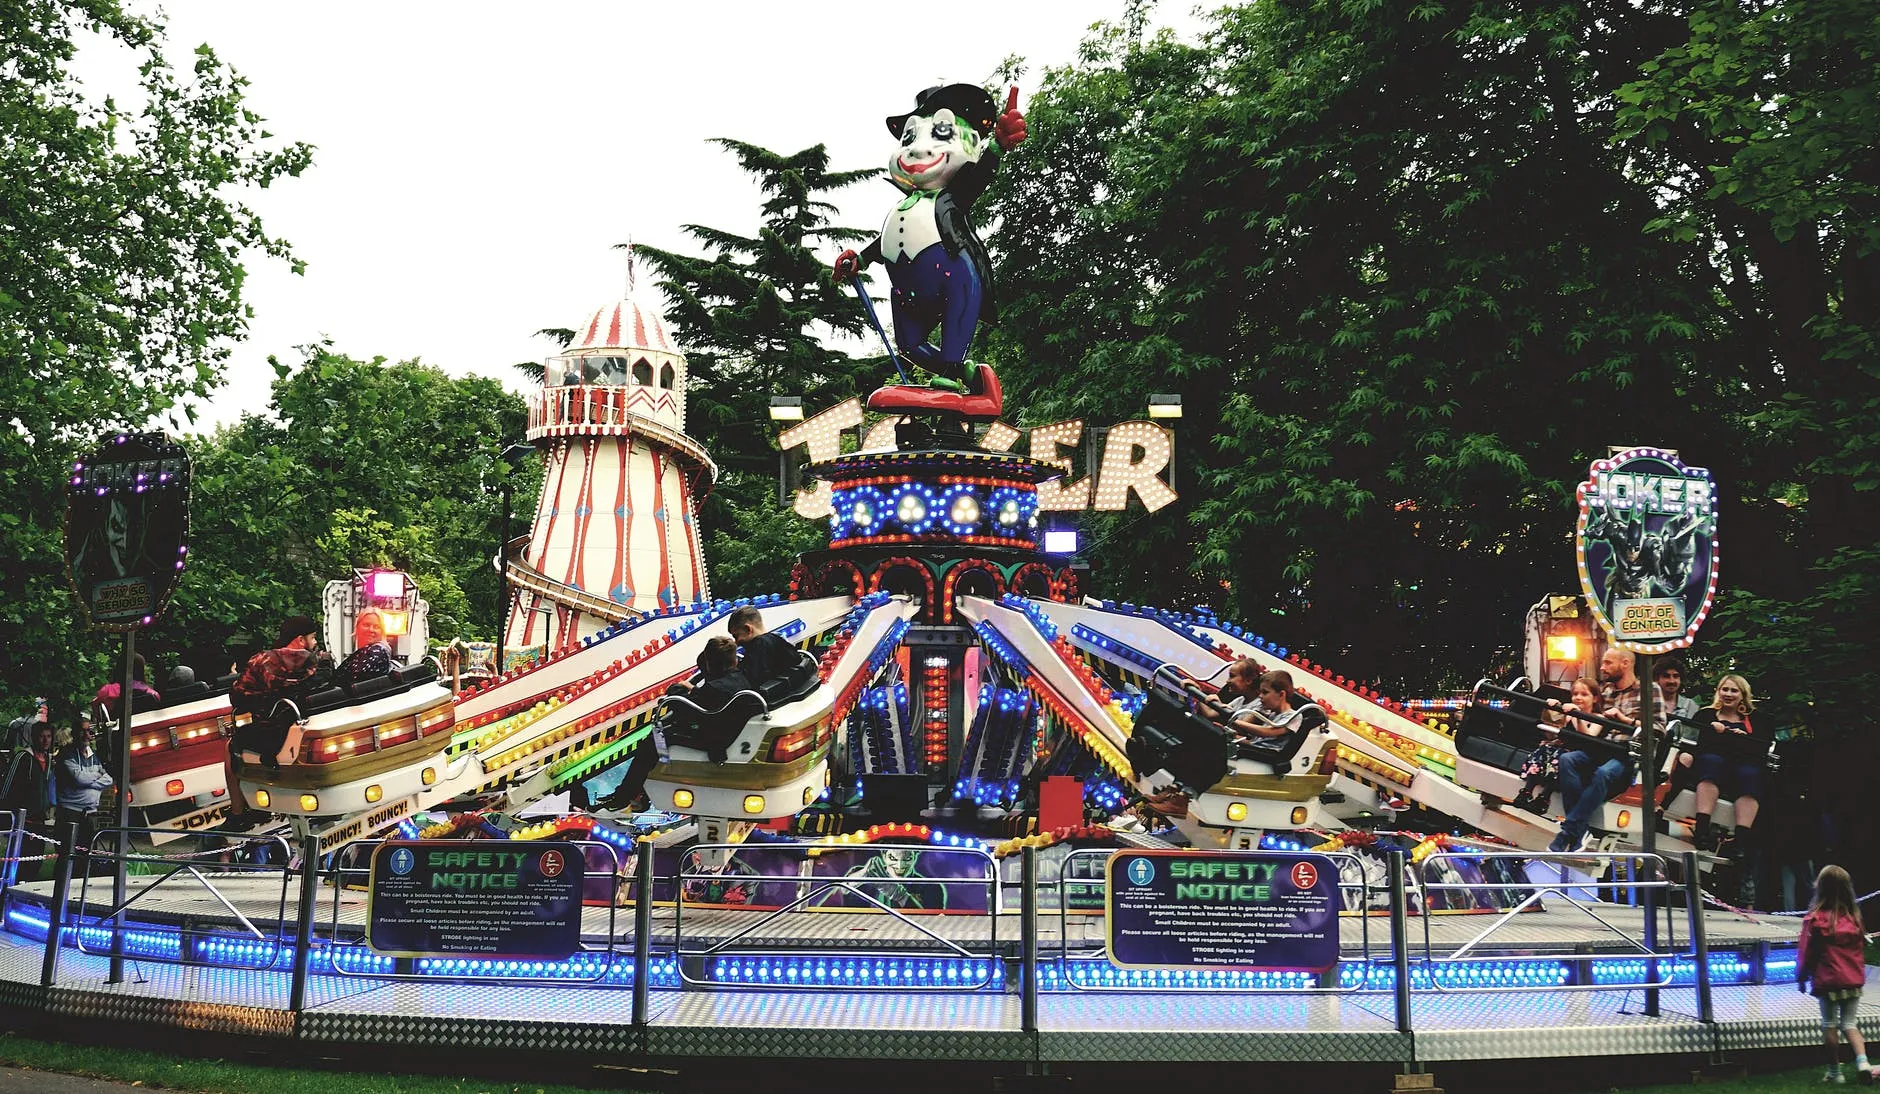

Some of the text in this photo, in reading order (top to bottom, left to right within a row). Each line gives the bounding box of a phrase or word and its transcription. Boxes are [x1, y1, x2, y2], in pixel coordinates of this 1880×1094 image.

[777, 397, 1178, 519] JER
[1585, 471, 1711, 514] JOKER
[101, 585, 146, 599] WHY SO
[1626, 607, 1673, 620] OUT OF
[1622, 618, 1679, 630] CONTROL
[289, 746, 294, 758] 1
[740, 741, 750, 754] 2
[1302, 756, 1310, 767] 3
[321, 800, 408, 850] BOUNCY! BOUNCY!
[707, 826, 718, 841] 2
[428, 852, 528, 868] SAFETY
[1170, 862, 1278, 880] SAFETY
[432, 872, 520, 889] NOTICE
[1176, 884, 1271, 900] NOTICE
